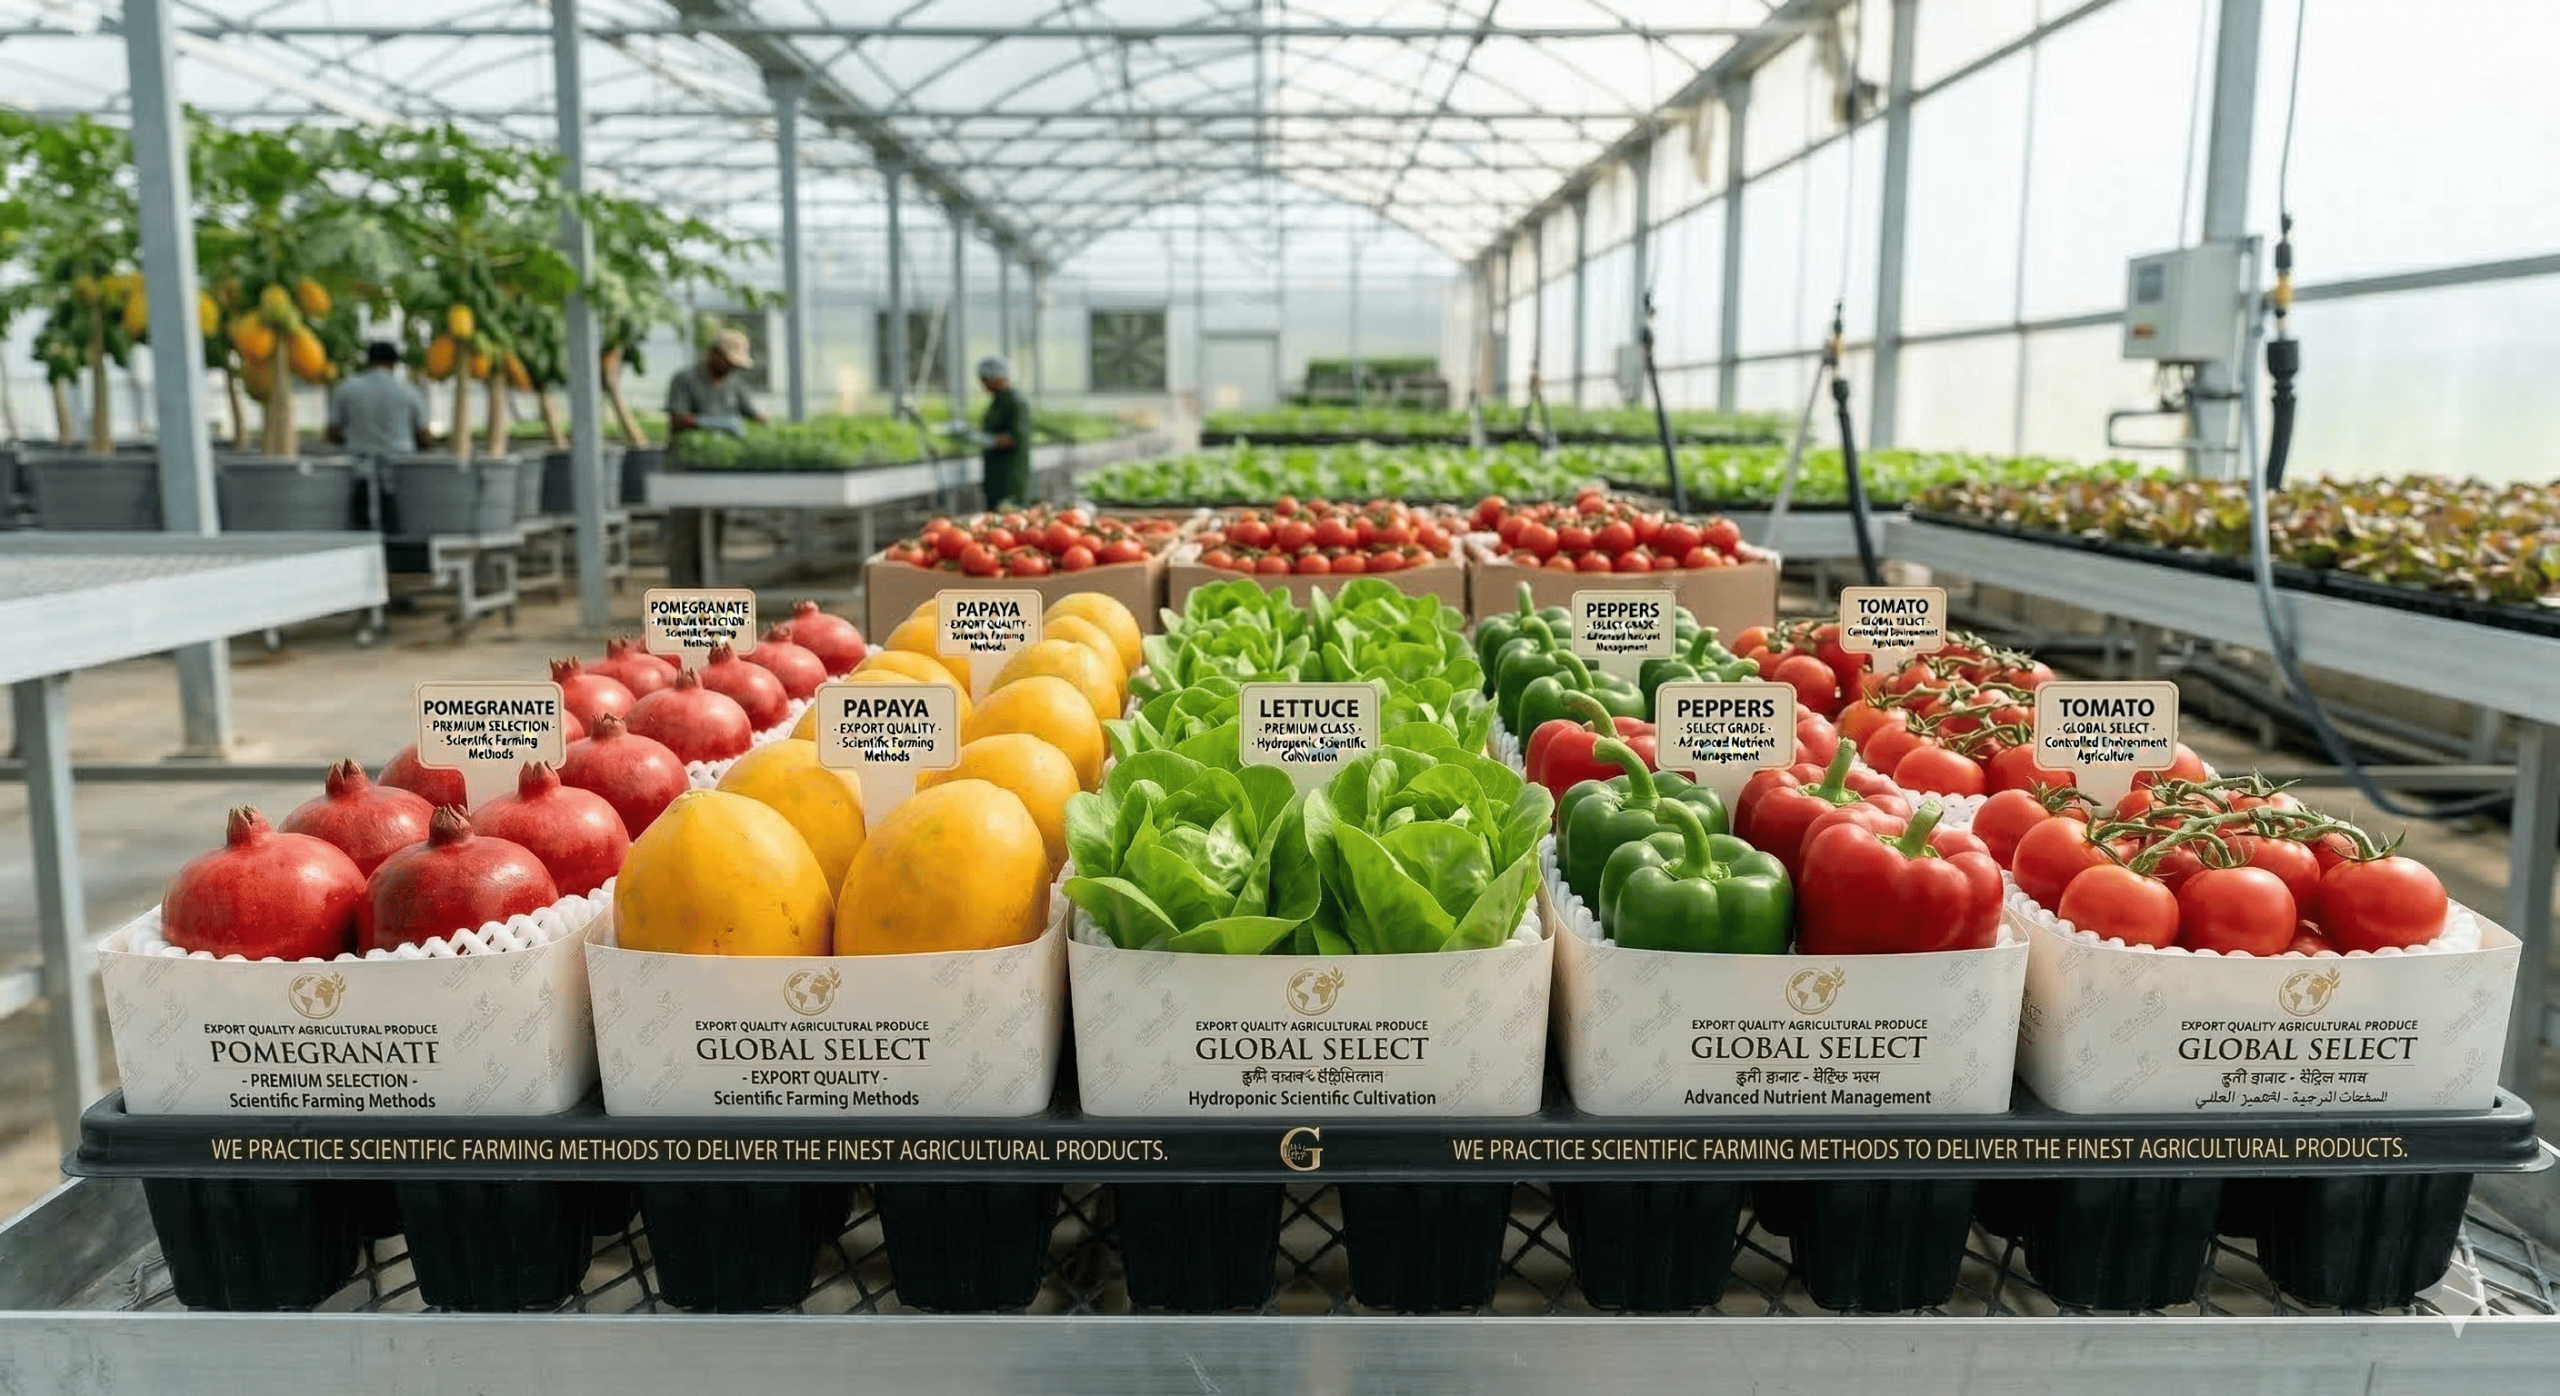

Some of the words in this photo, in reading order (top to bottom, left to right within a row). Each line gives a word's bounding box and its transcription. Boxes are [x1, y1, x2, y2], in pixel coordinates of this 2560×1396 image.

[651, 601, 749, 615] POMEGRANATE
[957, 602, 1021, 617] PAPAYA
[1586, 602, 1660, 618] PEPPERS
[1857, 598, 1929, 614] TOMATO
[424, 700, 554, 716] POMEGRANATE
[844, 699, 930, 717] PAPAYA
[1260, 699, 1359, 717] LETTUCE
[1678, 699, 1775, 718] PEPPERS
[2059, 698, 2155, 717] TOMATO
[840, 722, 884, 734] EXPORT
[886, 722, 936, 734] QUALITY
[1265, 723, 1318, 734] PREMIUM
[1320, 723, 1356, 734] CLASS
[1686, 722, 1726, 734] SELECT
[1727, 722, 1765, 734] GRADE
[2109, 722, 2150, 734] SELECT
[204, 1024, 246, 1034] EXPORT
[248, 1024, 296, 1036] QUALITY
[298, 1025, 383, 1035] AGRICULTURAL
[384, 1024, 438, 1034] PRODUCE
[695, 1021, 738, 1031] EXPORT
[740, 1021, 788, 1033] QUALITY
[790, 1021, 874, 1032] AGRICULTURAL
[875, 1021, 930, 1031] PRODUCE
[1195, 1021, 1239, 1032] EXPORT
[1240, 1021, 1288, 1033] QUALITY
[1290, 1021, 1373, 1032] AGRICULTURAL
[1375, 1021, 1429, 1031] PRODUCE
[1692, 1020, 1736, 1030] EXPORT
[1737, 1020, 1786, 1032] QUALITY
[1788, 1020, 1873, 1031] AGRICULTURAL
[1874, 1019, 1928, 1030] PRODUCE
[2181, 1021, 2226, 1031] EXPORT
[2227, 1022, 2277, 1033] QUALITY
[2278, 1021, 2362, 1032] AGRICULTURAL
[2364, 1020, 2418, 1031] PRODUCE
[696, 1037, 815, 1061] GLOBAL
[824, 1037, 931, 1061] SELECT
[1195, 1037, 1314, 1061] GLOBAL
[1323, 1037, 1430, 1061] SELECT
[1691, 1035, 1810, 1059] GLOBAL
[1819, 1035, 1928, 1059] SELECT
[2178, 1037, 2299, 1060] GLOBAL
[2307, 1036, 2419, 1060] SELECT
[251, 1073, 323, 1088] PREMIUM
[326, 1073, 408, 1088] SELECTION
[751, 1070, 811, 1085] EXPORT
[813, 1070, 880, 1087] QUALITY
[229, 1092, 300, 1109] Scientific
[302, 1092, 365, 1111] Farming
[369, 1092, 436, 1108] Methods
[713, 1090, 784, 1106] Scientific
[786, 1090, 849, 1109] Farming
[852, 1090, 920, 1106] Methods
[1188, 1090, 1278, 1109] Hydroponic
[1280, 1089, 1350, 1106] Scientific
[1353, 1089, 1437, 1106] Cultivation
[1684, 1089, 1760, 1105] Advanced
[1763, 1089, 1828, 1105] Nutrient
[1830, 1089, 1932, 1108] Management
[212, 1139, 242, 1159] WE
[250, 1139, 344, 1159] PRACTICE
[350, 1139, 456, 1159] SCIENTIFIC
[463, 1139, 552, 1160] FARMING
[560, 1139, 658, 1160] METHODS
[664, 1139, 691, 1160] TO
[697, 1139, 777, 1160] DELIVER
[783, 1139, 821, 1160] THE
[828, 1139, 895, 1160] FINEST
[900, 1139, 1051, 1160] AGRICULTURAL
[1056, 1139, 1168, 1160] PRODUCTS.
[1280, 1126, 1323, 1171] G
[1453, 1139, 1483, 1160] WE
[1491, 1139, 1586, 1160] PRACTICE
[1592, 1139, 1698, 1160] SCIENTIFIC
[1704, 1139, 1794, 1160] FARMING
[1800, 1139, 1900, 1160] METHODS
[1904, 1139, 1932, 1160] TO
[1938, 1138, 2018, 1159] DELIVER
[2022, 1138, 2061, 1159] THE
[2068, 1138, 2135, 1159] FINEST
[2140, 1138, 2290, 1159] AGRICULTURAL
[2296, 1137, 2411, 1159] PRODUCTS.
